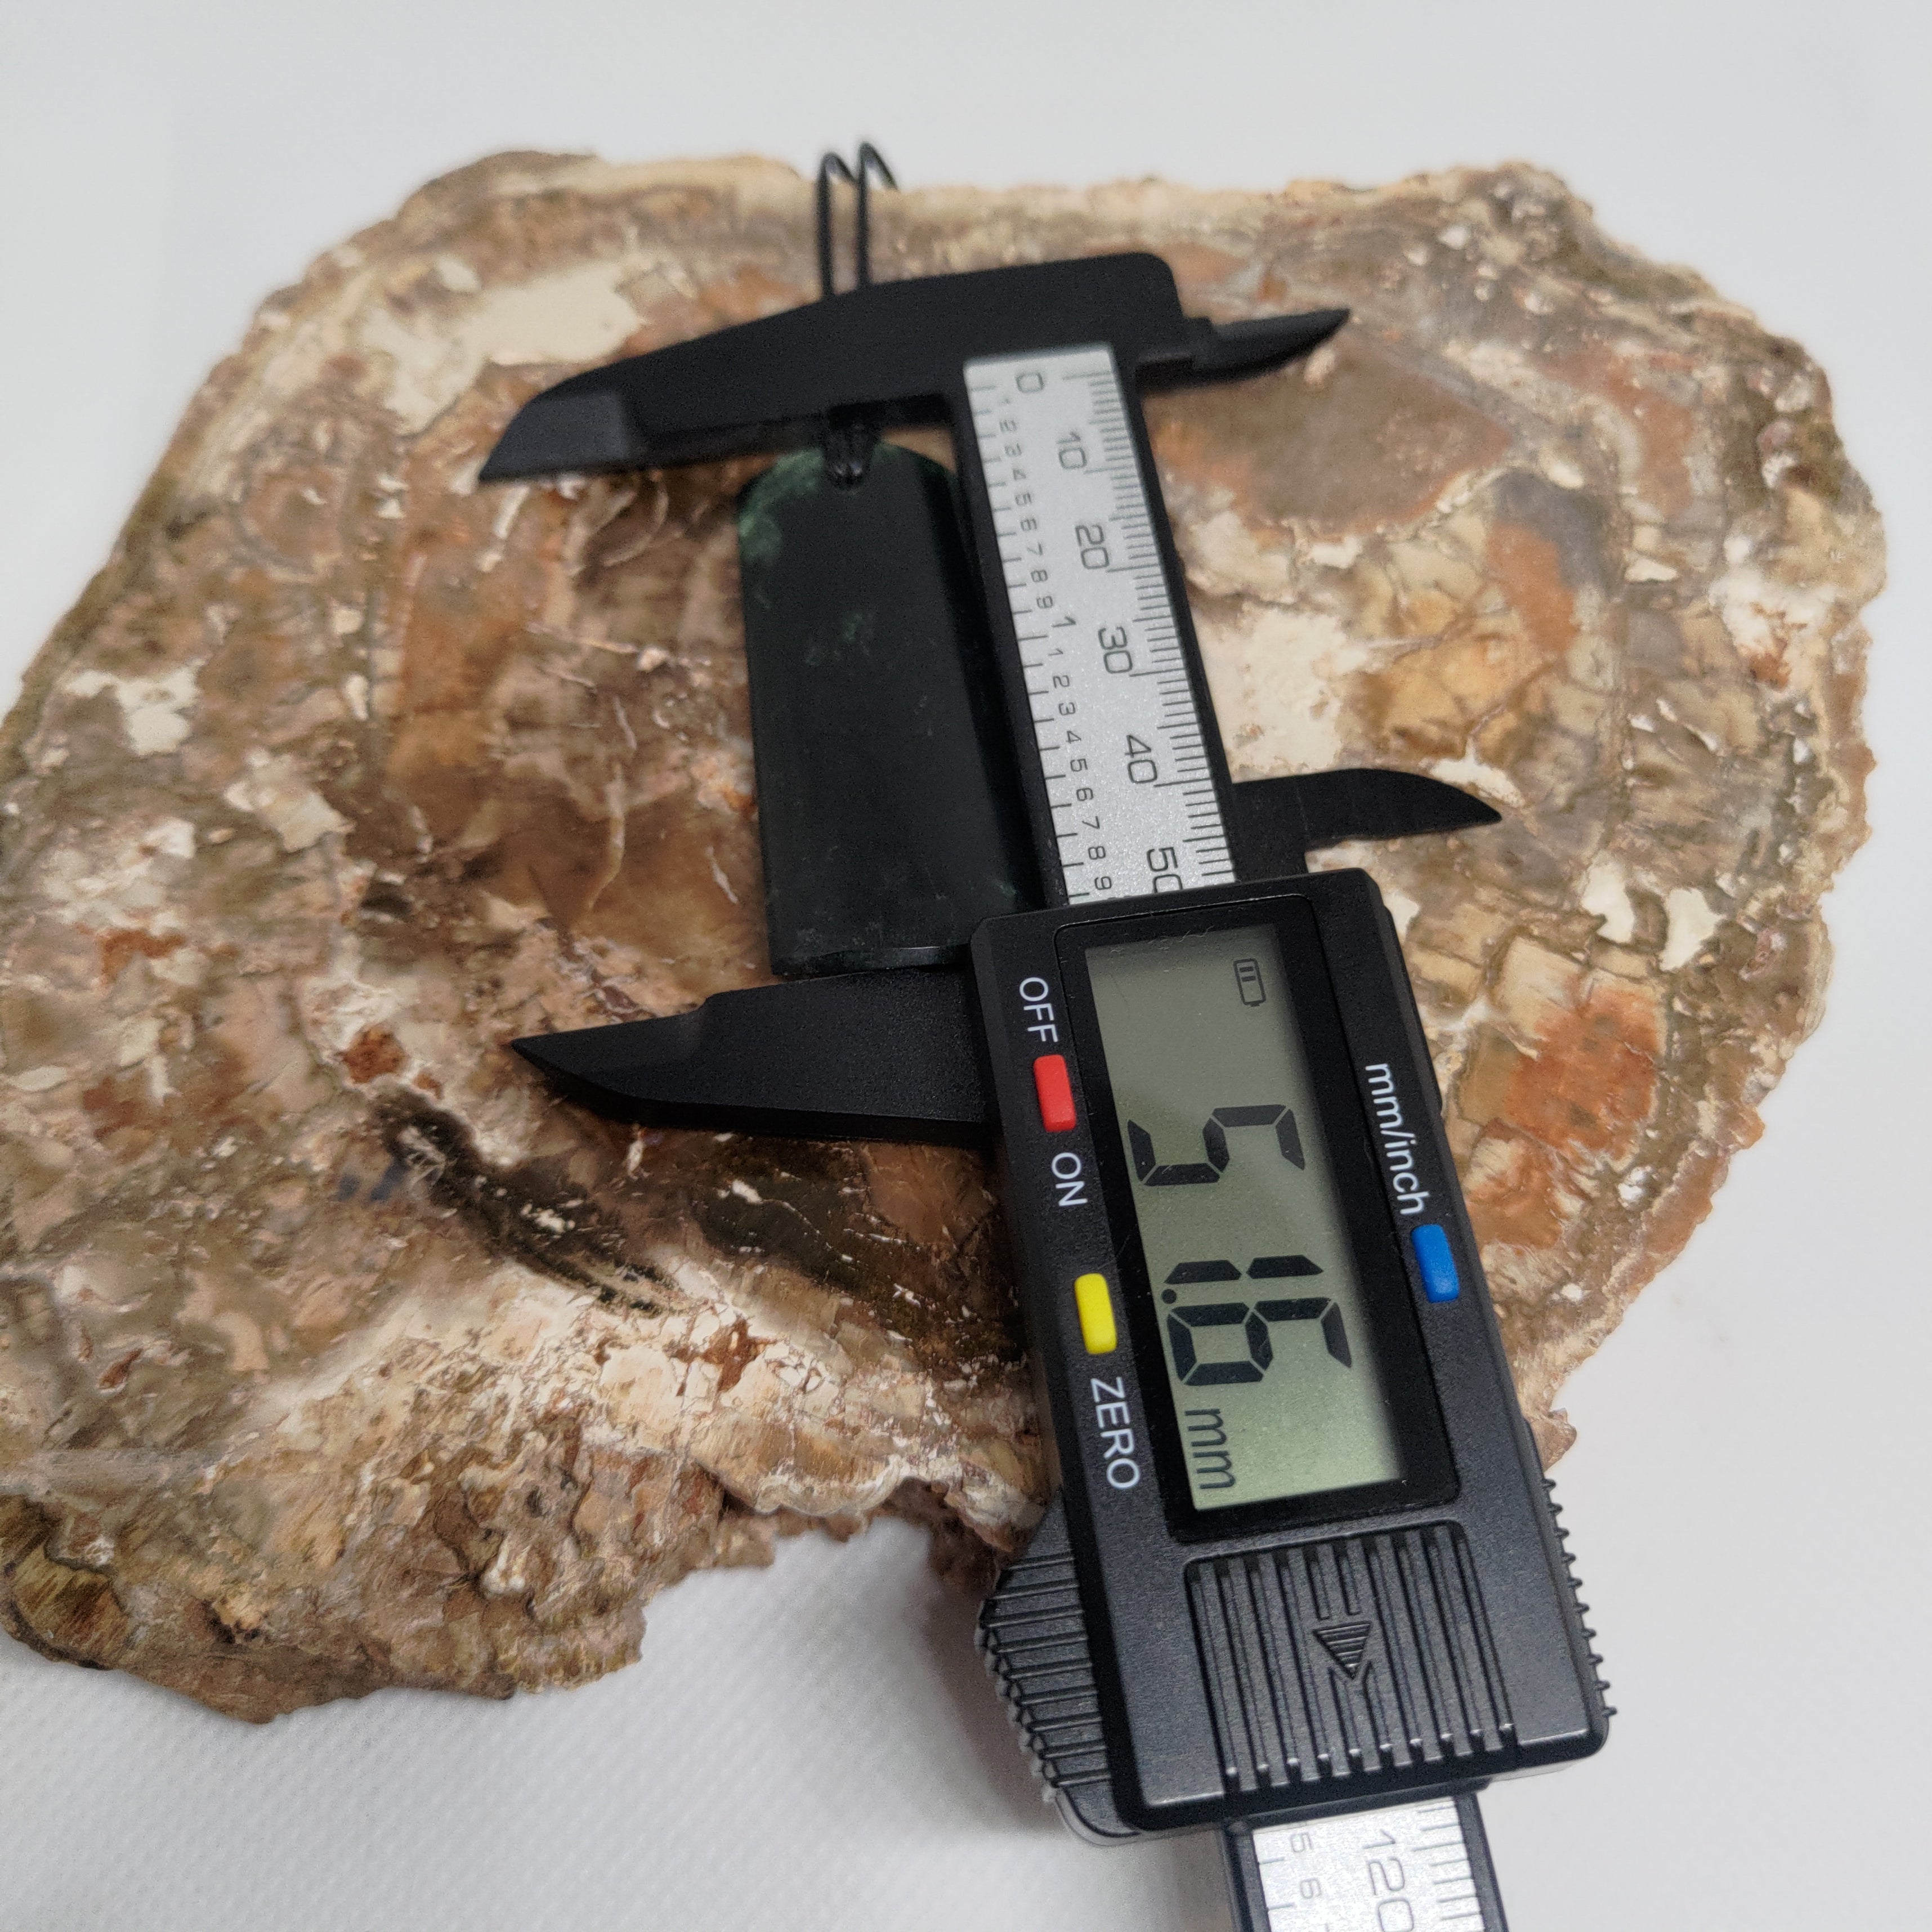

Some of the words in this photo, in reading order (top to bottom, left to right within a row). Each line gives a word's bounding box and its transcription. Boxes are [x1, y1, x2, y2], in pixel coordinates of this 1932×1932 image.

[1005, 444, 1021, 456] 3
[1013, 469, 1027, 480] 4
[1016, 493, 1032, 504] 5
[1020, 518, 1037, 530] 6
[1027, 543, 1043, 556] 7
[1016, 372, 1044, 392] 0
[1056, 431, 1087, 469] 10
[1075, 524, 1109, 569] 20
[1098, 626, 1133, 674] 30
[1125, 734, 1158, 784] 40
[1031, 570, 1049, 582] 8
[1036, 595, 1053, 609] 9
[1052, 615, 1076, 628] 1
[1048, 647, 1063, 657] 1
[1053, 676, 1070, 688] 2
[1058, 702, 1076, 715] 3
[1066, 730, 1081, 743] 4
[1070, 758, 1088, 772] 5
[1076, 787, 1094, 801] 6
[1082, 816, 1100, 829] 7
[1088, 846, 1106, 860] 8
[1094, 875, 1112, 890] 9
[1019, 977, 1058, 1043] OFF
[1366, 1063, 1429, 1215] mm/inch
[1051, 1152, 1088, 1206] ON
[1128, 1104, 1352, 1386] 51.6
[1090, 1376, 1140, 1488] ZERO
[1184, 1408, 1237, 1491] mm
[1290, 1831, 1312, 1853] 5
[1363, 1829, 1414, 1932] 120
[1300, 1878, 1321, 1899] 6
